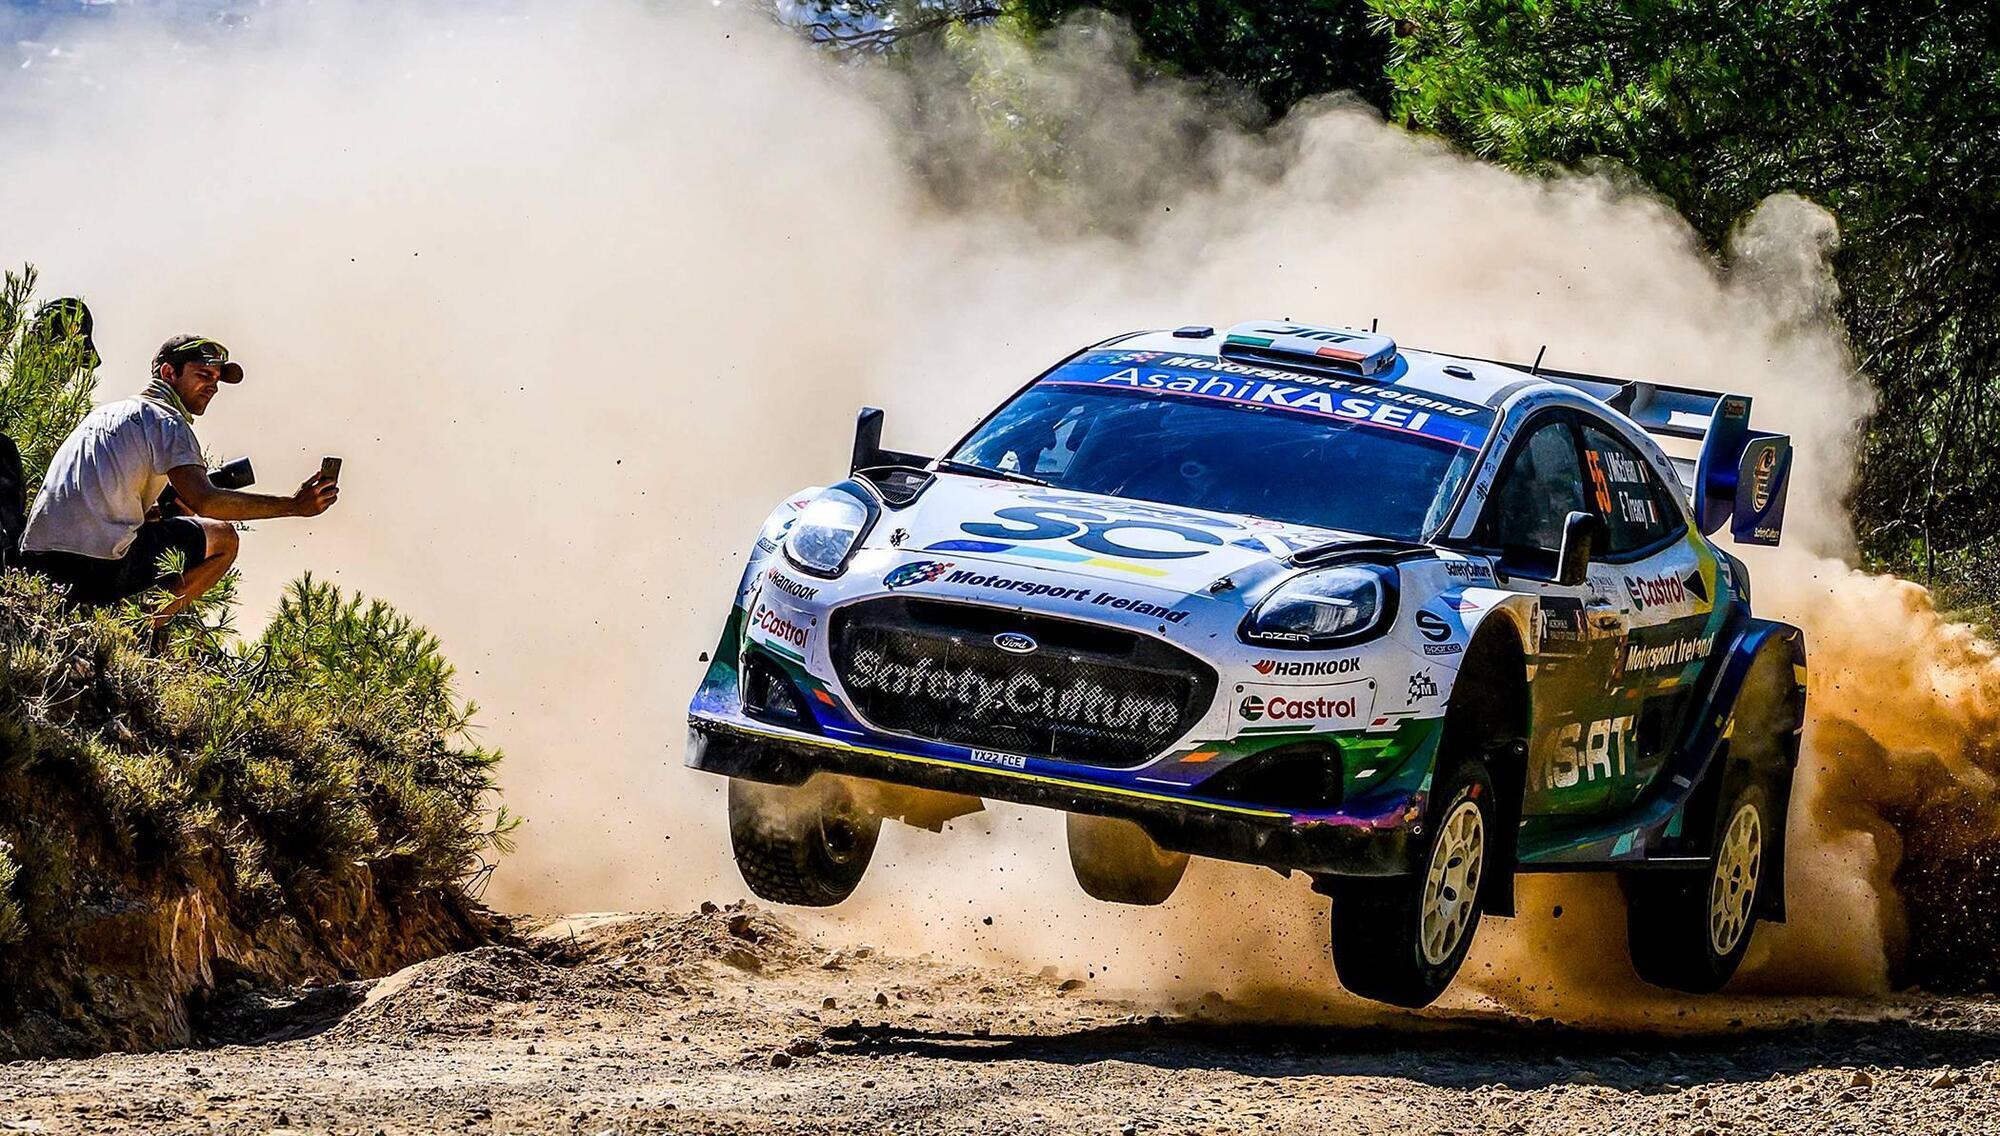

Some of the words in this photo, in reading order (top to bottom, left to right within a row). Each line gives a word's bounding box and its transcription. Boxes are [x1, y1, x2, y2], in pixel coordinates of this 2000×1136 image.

[1097, 367, 1431, 433] AsahiKASEI
[1162, 355, 1352, 390] Motorsport
[1350, 384, 1480, 418] Ireland
[1585, 450, 1612, 513] 55
[959, 506, 1225, 560] SC
[1444, 561, 1492, 581] SafetyCulture
[1636, 570, 1686, 607] Castrol
[944, 569, 1092, 602] Motorsport
[1096, 591, 1190, 625] Ireland
[759, 609, 811, 649] Castrol
[1001, 635, 1030, 651] Ford
[1247, 630, 1310, 643] LAZER
[1624, 641, 1677, 672] Motorsport
[1676, 631, 1715, 664] Ireland
[848, 646, 1179, 736] SafetyCulture
[1266, 696, 1356, 720] Castrol
[971, 749, 999, 765] YX22
[1000, 753, 1023, 769] FCE
